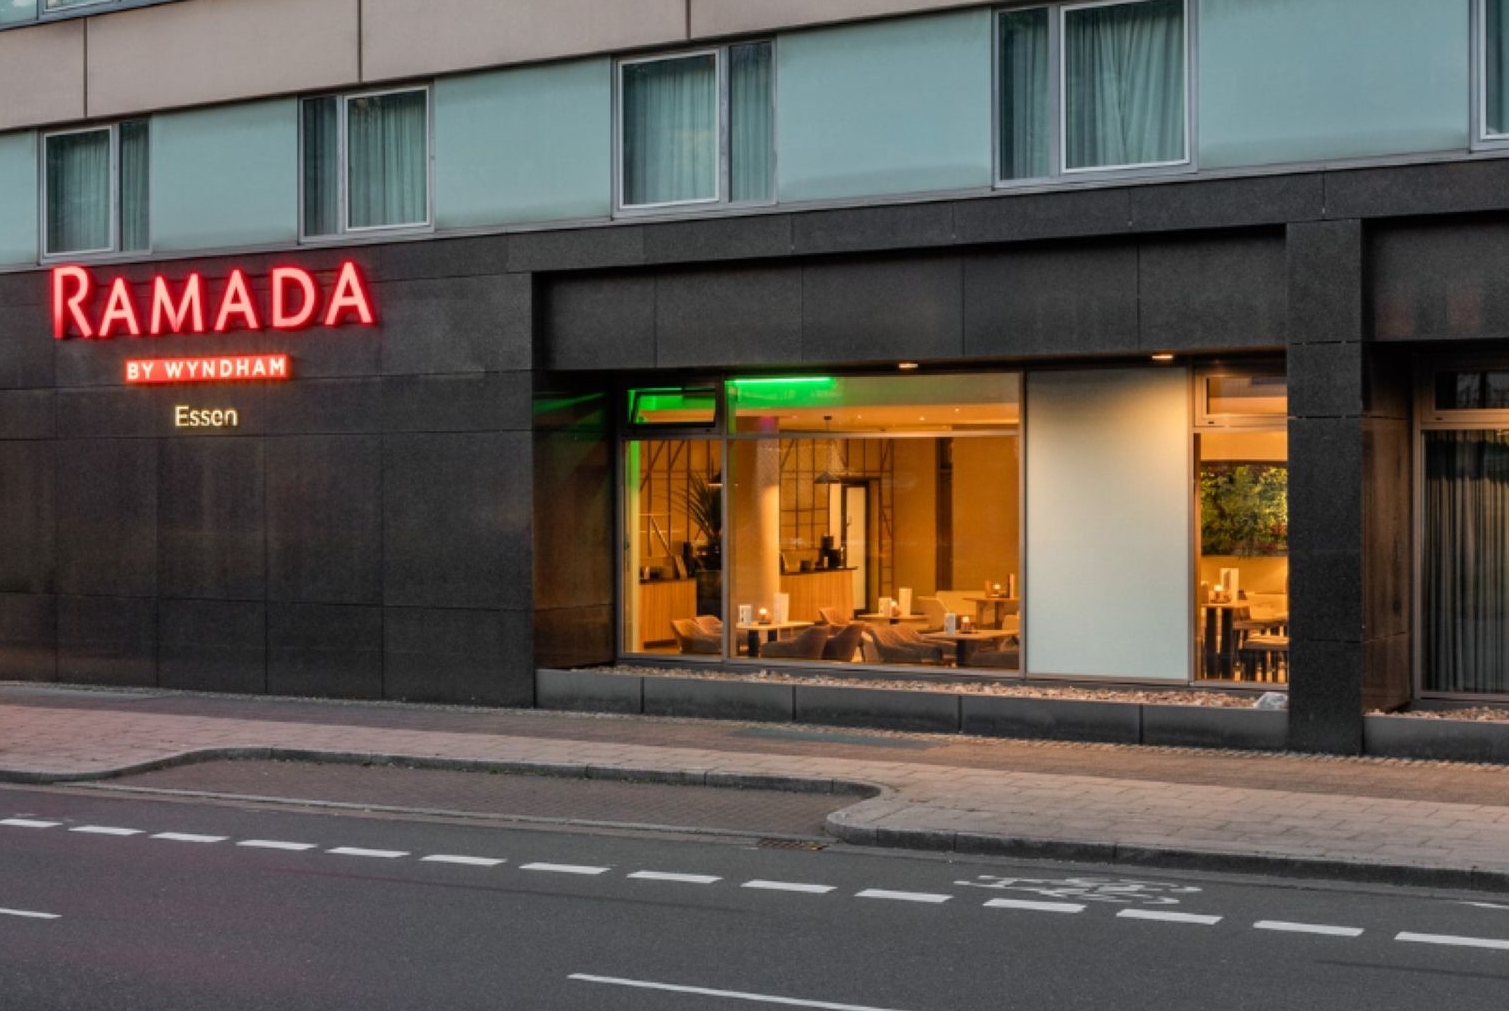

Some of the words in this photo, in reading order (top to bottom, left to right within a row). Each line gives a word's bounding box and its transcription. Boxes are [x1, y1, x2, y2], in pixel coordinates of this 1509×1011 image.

[52, 259, 375, 338] RAMADA
[127, 360, 154, 380] BY
[165, 358, 287, 378] WYNDHAM
[174, 404, 238, 427] Essen
